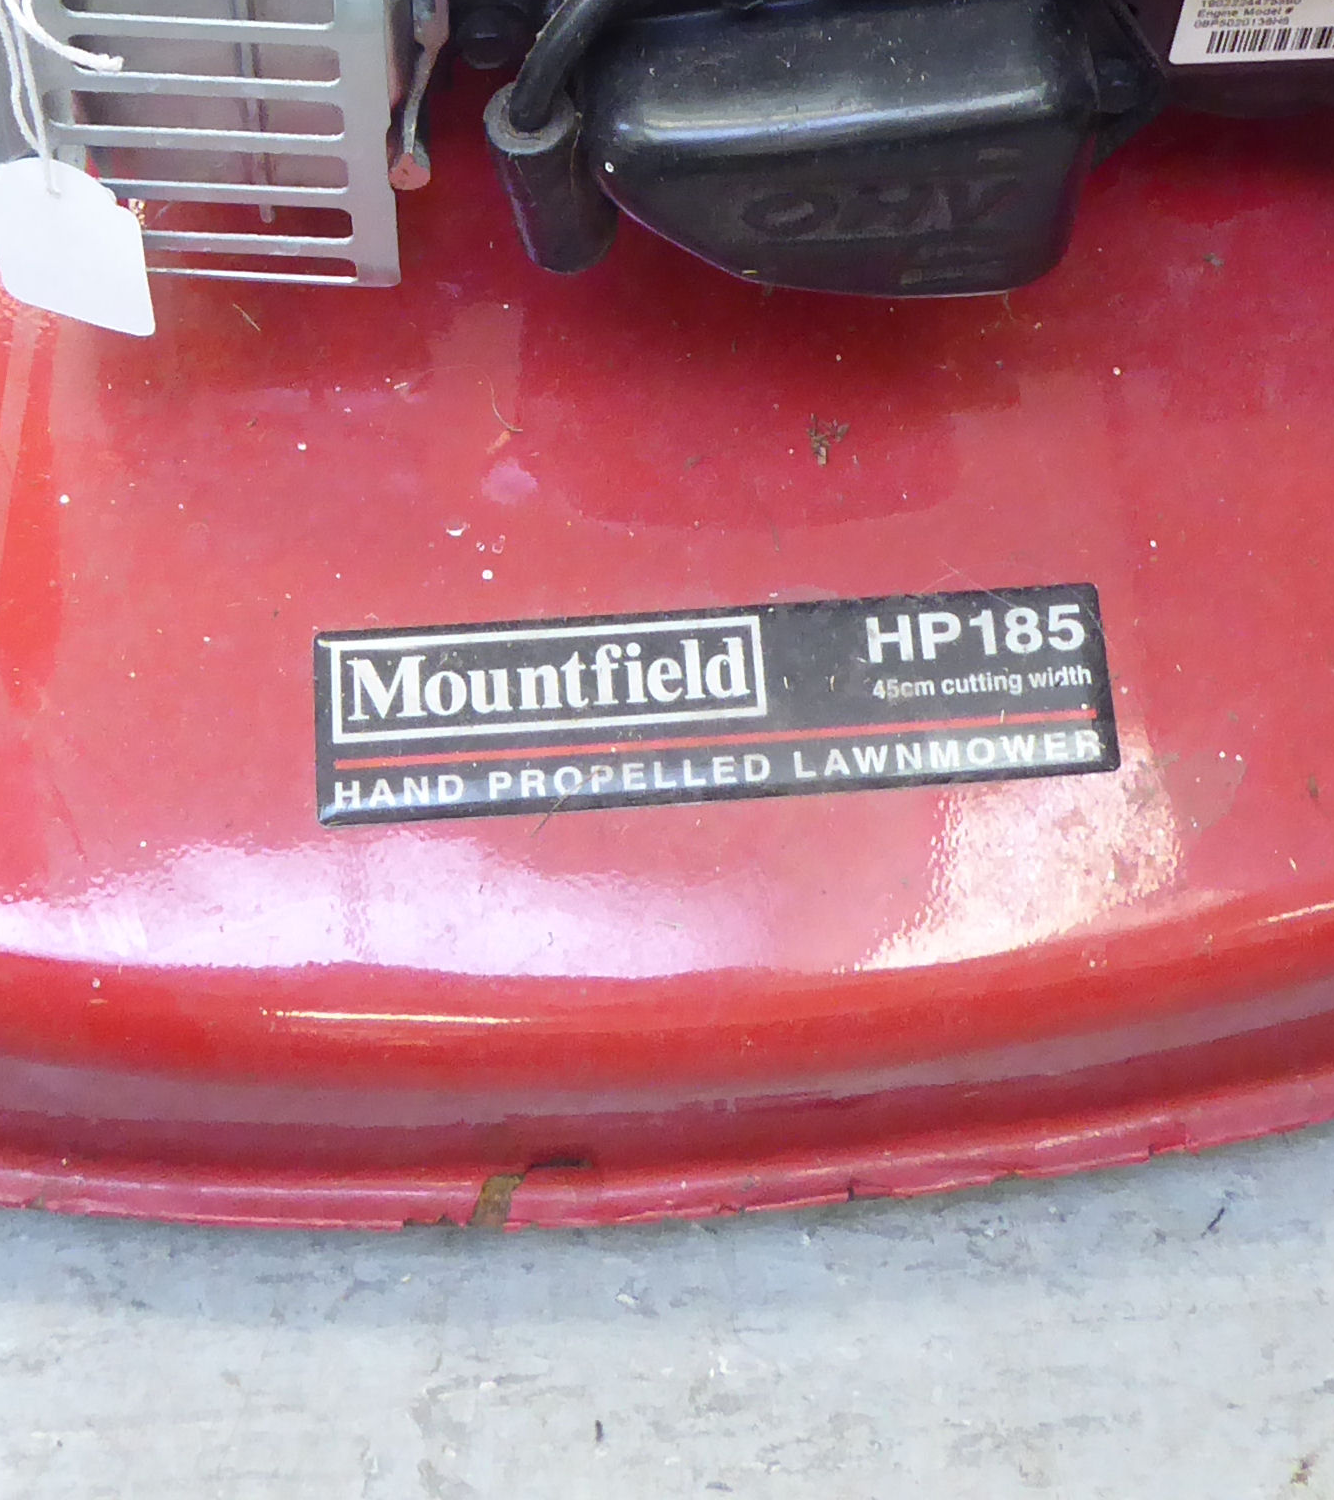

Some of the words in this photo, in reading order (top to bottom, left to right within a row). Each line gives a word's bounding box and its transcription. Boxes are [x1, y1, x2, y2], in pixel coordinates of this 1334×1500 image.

[1197, 9, 1238, 18] Engine
[1244, 7, 1282, 16] Model
[865, 603, 1086, 665] HP185
[346, 634, 752, 723] Mountfield
[871, 677, 935, 700] 45cm
[940, 669, 1023, 700] cutting
[1028, 664, 1093, 693] width
[333, 774, 466, 811] HAND
[486, 754, 772, 802] PROPELLED
[793, 728, 1103, 782] LAWNMOWER
